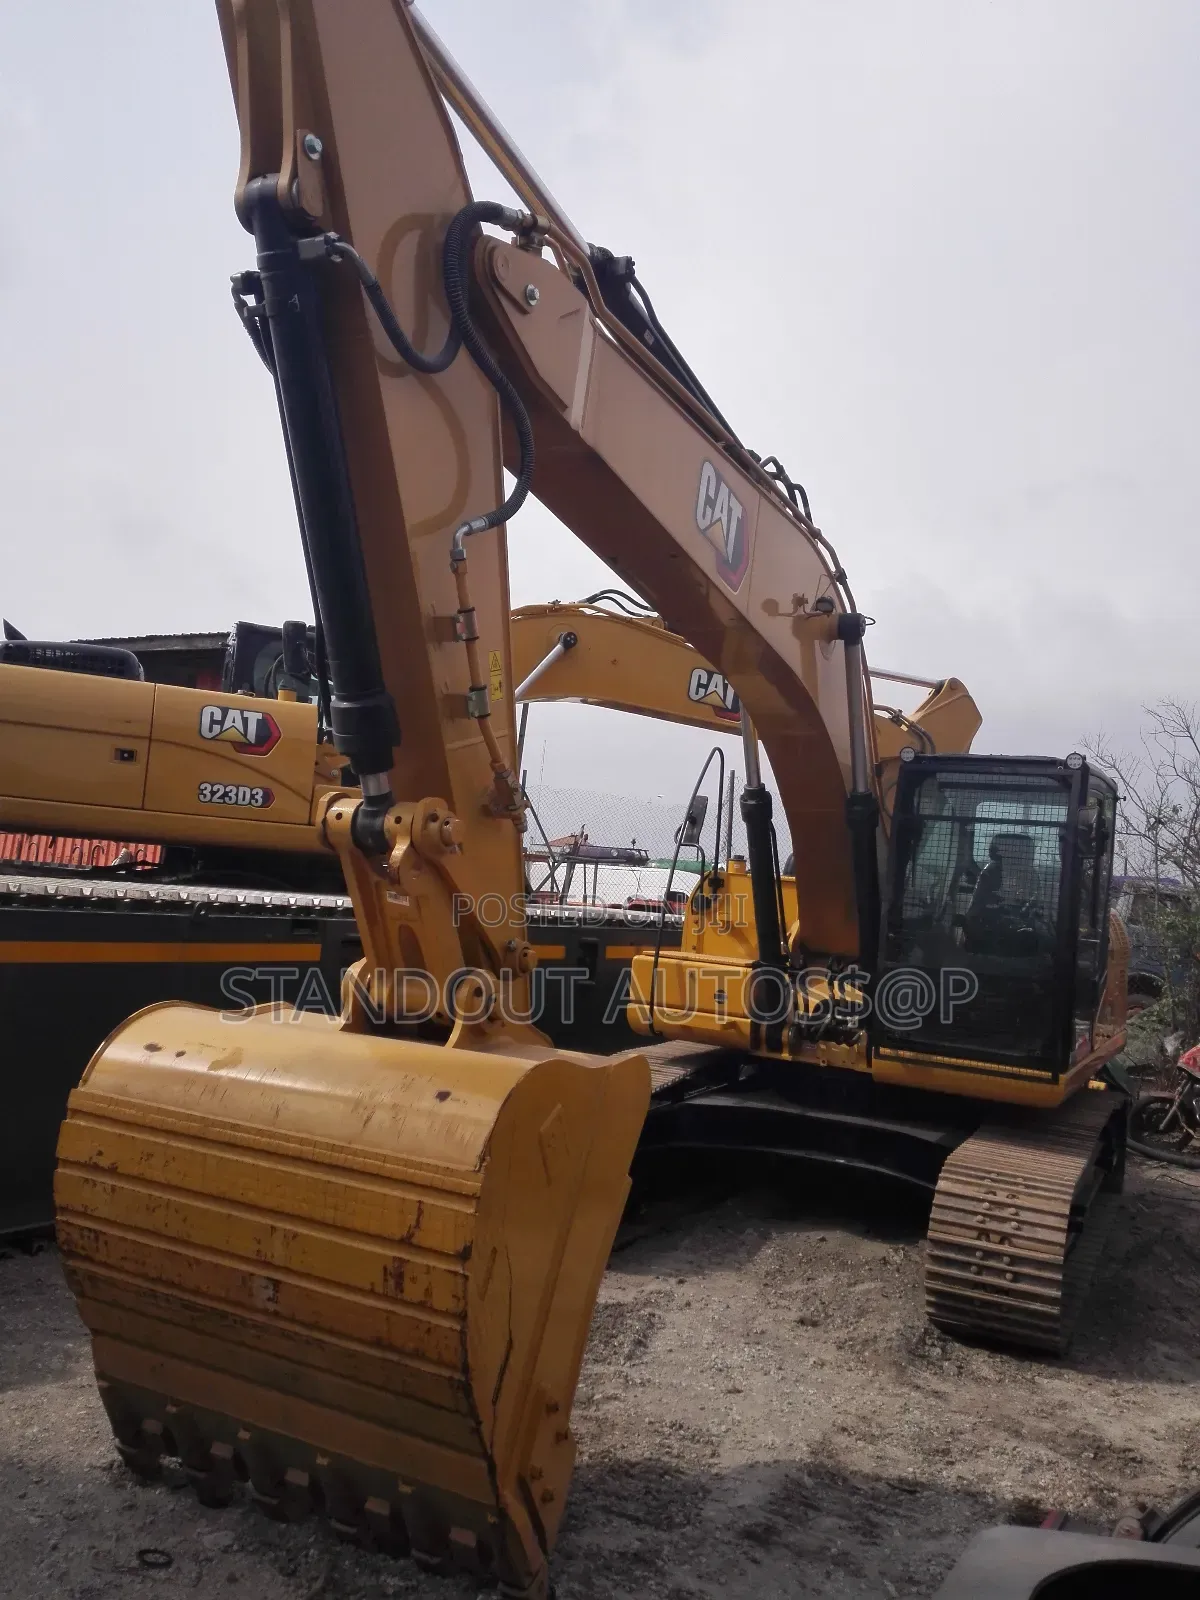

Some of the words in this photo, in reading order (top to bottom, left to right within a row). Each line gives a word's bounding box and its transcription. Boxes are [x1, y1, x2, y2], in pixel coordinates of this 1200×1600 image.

[696, 461, 742, 563] CAT
[200, 705, 262, 744] CAT
[199, 783, 263, 807] 323D3
